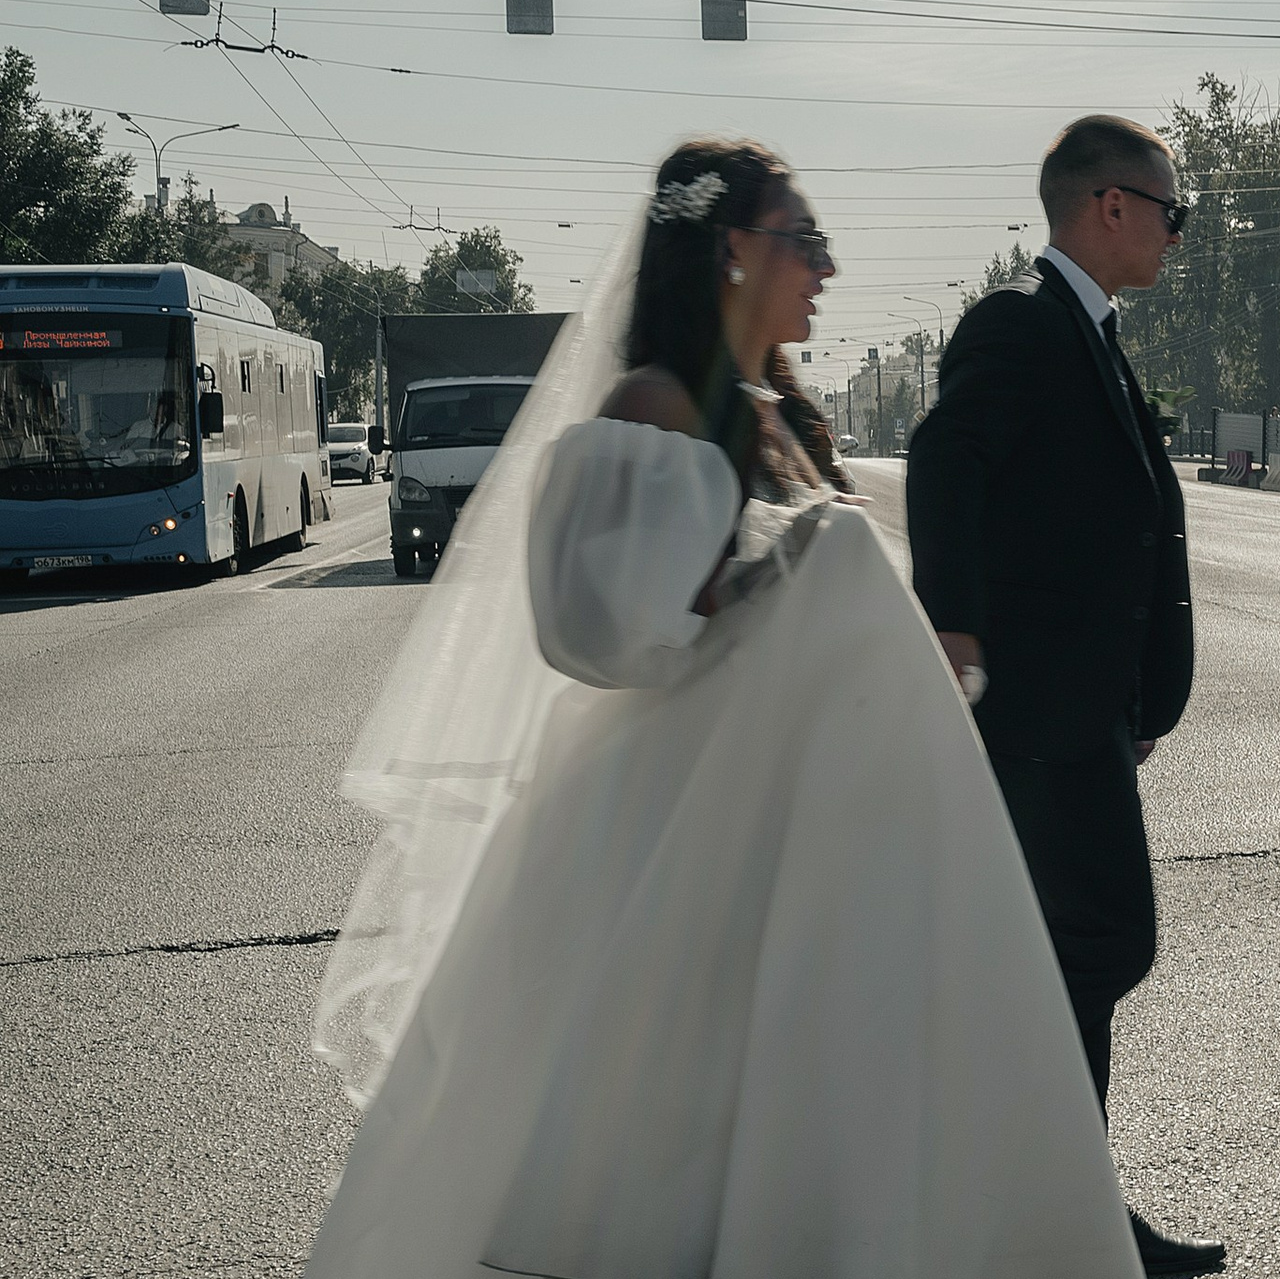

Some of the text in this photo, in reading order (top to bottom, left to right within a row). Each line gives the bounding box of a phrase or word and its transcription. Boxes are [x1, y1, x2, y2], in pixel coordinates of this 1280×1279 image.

[25, 330, 106, 340] Промышленная
[23, 338, 110, 348] Лизы Чайкиной
